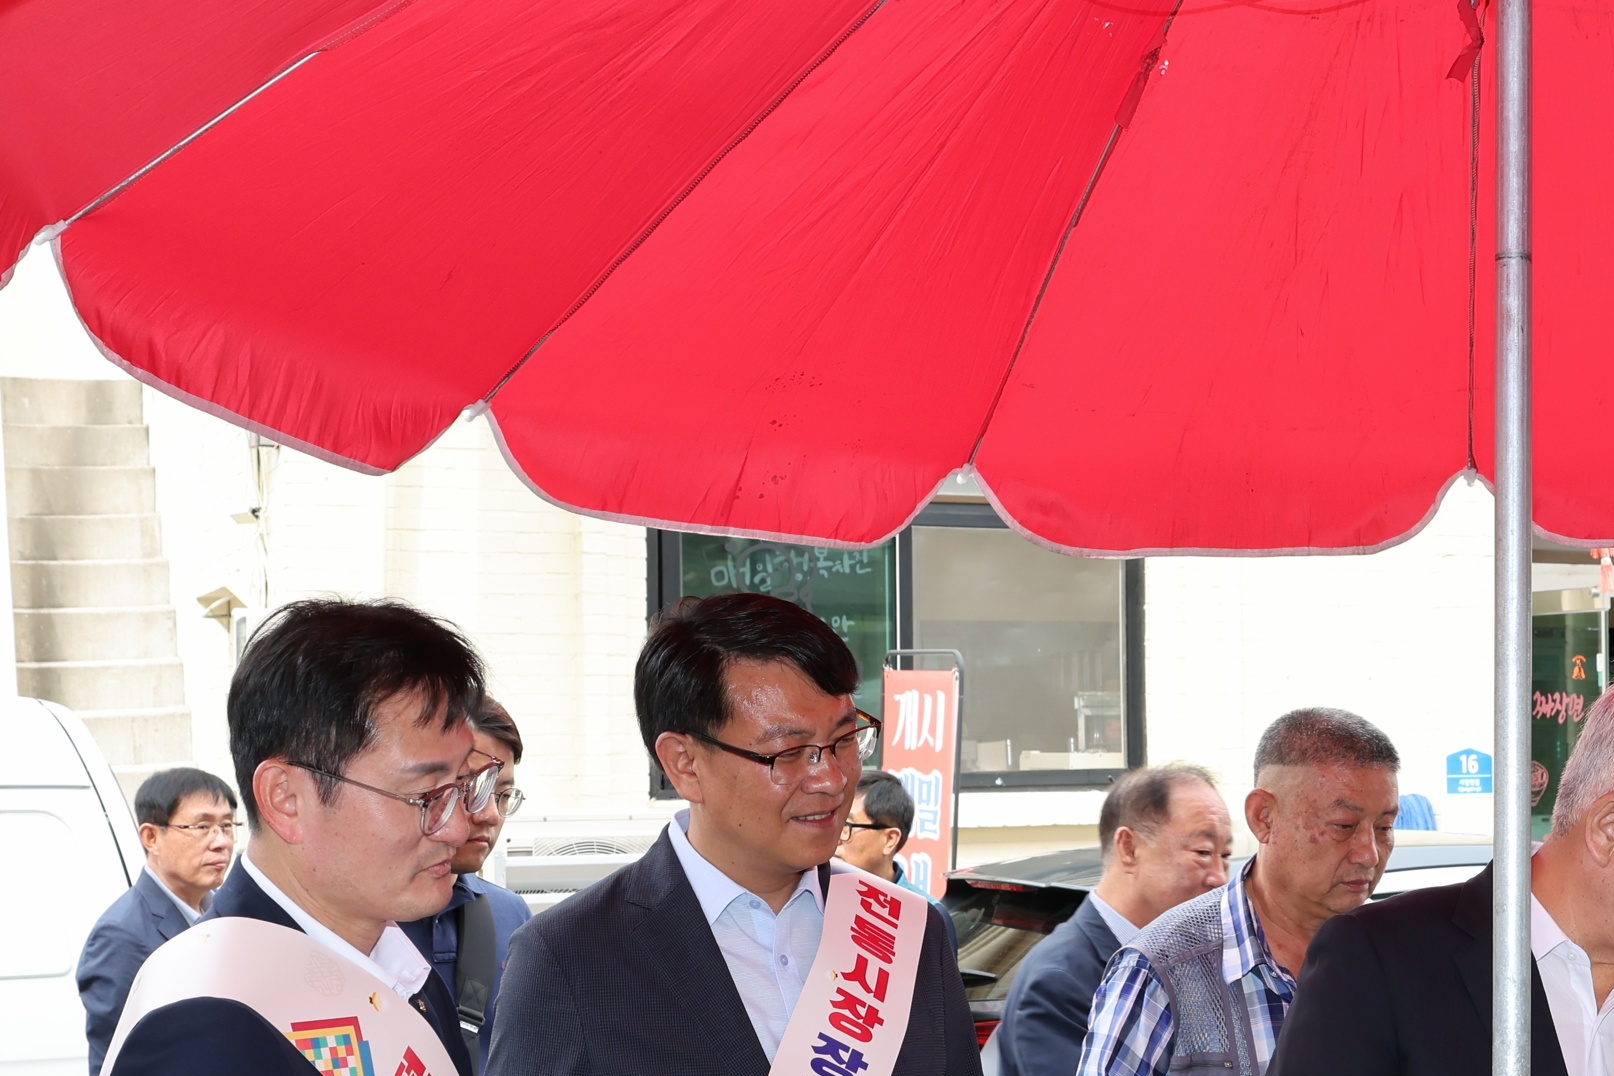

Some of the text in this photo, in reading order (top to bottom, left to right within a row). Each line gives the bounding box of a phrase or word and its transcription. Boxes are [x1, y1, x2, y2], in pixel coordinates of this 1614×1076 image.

[891, 688, 946, 752] 개시
[1532, 690, 1585, 725] 짜장면
[1459, 754, 1480, 774] 16
[829, 880, 902, 1043] 전통시장
